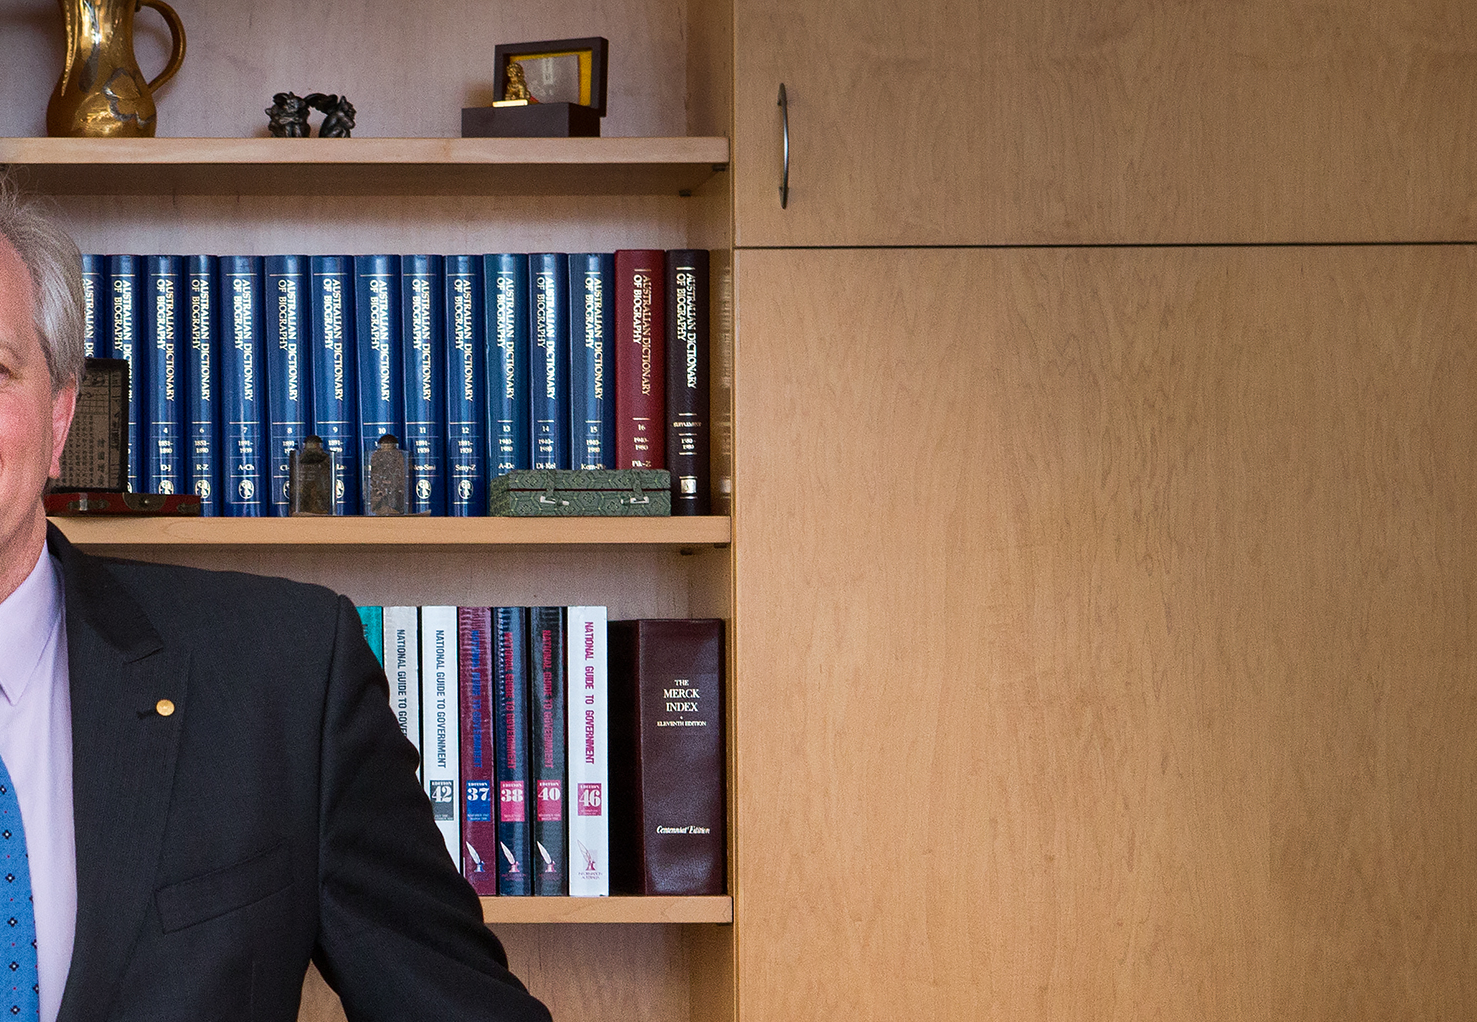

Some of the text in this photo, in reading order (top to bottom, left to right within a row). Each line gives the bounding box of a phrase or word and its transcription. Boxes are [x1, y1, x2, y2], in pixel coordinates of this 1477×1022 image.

[157, 279, 166, 350] OF BIOGRAPHY
[165, 280, 175, 401] AUSTRALIAN DICTIONARY
[191, 279, 200, 350] OF BIOGRAPHY
[200, 280, 210, 401] AUSTRALIAN DICTIONARY
[233, 279, 243, 350] OF BIOGRAPHY
[242, 280, 253, 401] AUSTRALIAN DICTIONARY
[323, 278, 333, 350] OF BIOGRAPHY
[332, 280, 343, 401] AUSTRALIAN DICTIONARY
[412, 279, 422, 350] OF BIOGRAPHY
[421, 280, 431, 401] AUSTRALIAN DICTIONARY
[496, 277, 506, 348] OF BIOGRAPHY
[505, 278, 514, 400] AUSTRALIAN DICTIONARY
[536, 277, 546, 348] OF BIOGRAPHY
[545, 277, 556, 400] AUSTRALIAN DICTIONARY
[585, 278, 594, 349] OF BIOGRAPHY
[594, 278, 603, 400] AUSTRALIAN DICTIONARY
[633, 274, 642, 344] OF BIOGRAPHY
[642, 275, 651, 396] AUSTRALIAN DICTIONARY
[676, 273, 686, 341] OF BIOGRAPHY
[686, 273, 696, 388] AUSTRALIAN DICTIONARY
[332, 426, 338, 434] 9
[419, 426, 426, 434] 11
[462, 426, 470, 434] 12
[396, 630, 406, 670] NATIONAL
[397, 671, 406, 696] GUIDE
[398, 698, 407, 709] TO
[436, 630, 446, 768] NATIONAL GUIDE TO GOVERNMENT
[584, 622, 594, 764] NATIONAL GUIDE TO GOVERNMENT
[664, 688, 700, 698] MERCK
[666, 702, 698, 712] INDEX
[432, 786, 452, 802] 42
[467, 788, 490, 802] 37
[501, 789, 524, 802] 38
[538, 787, 561, 801] 40
[578, 790, 601, 807] 46
[656, 826, 710, 834] Centennial Edition
